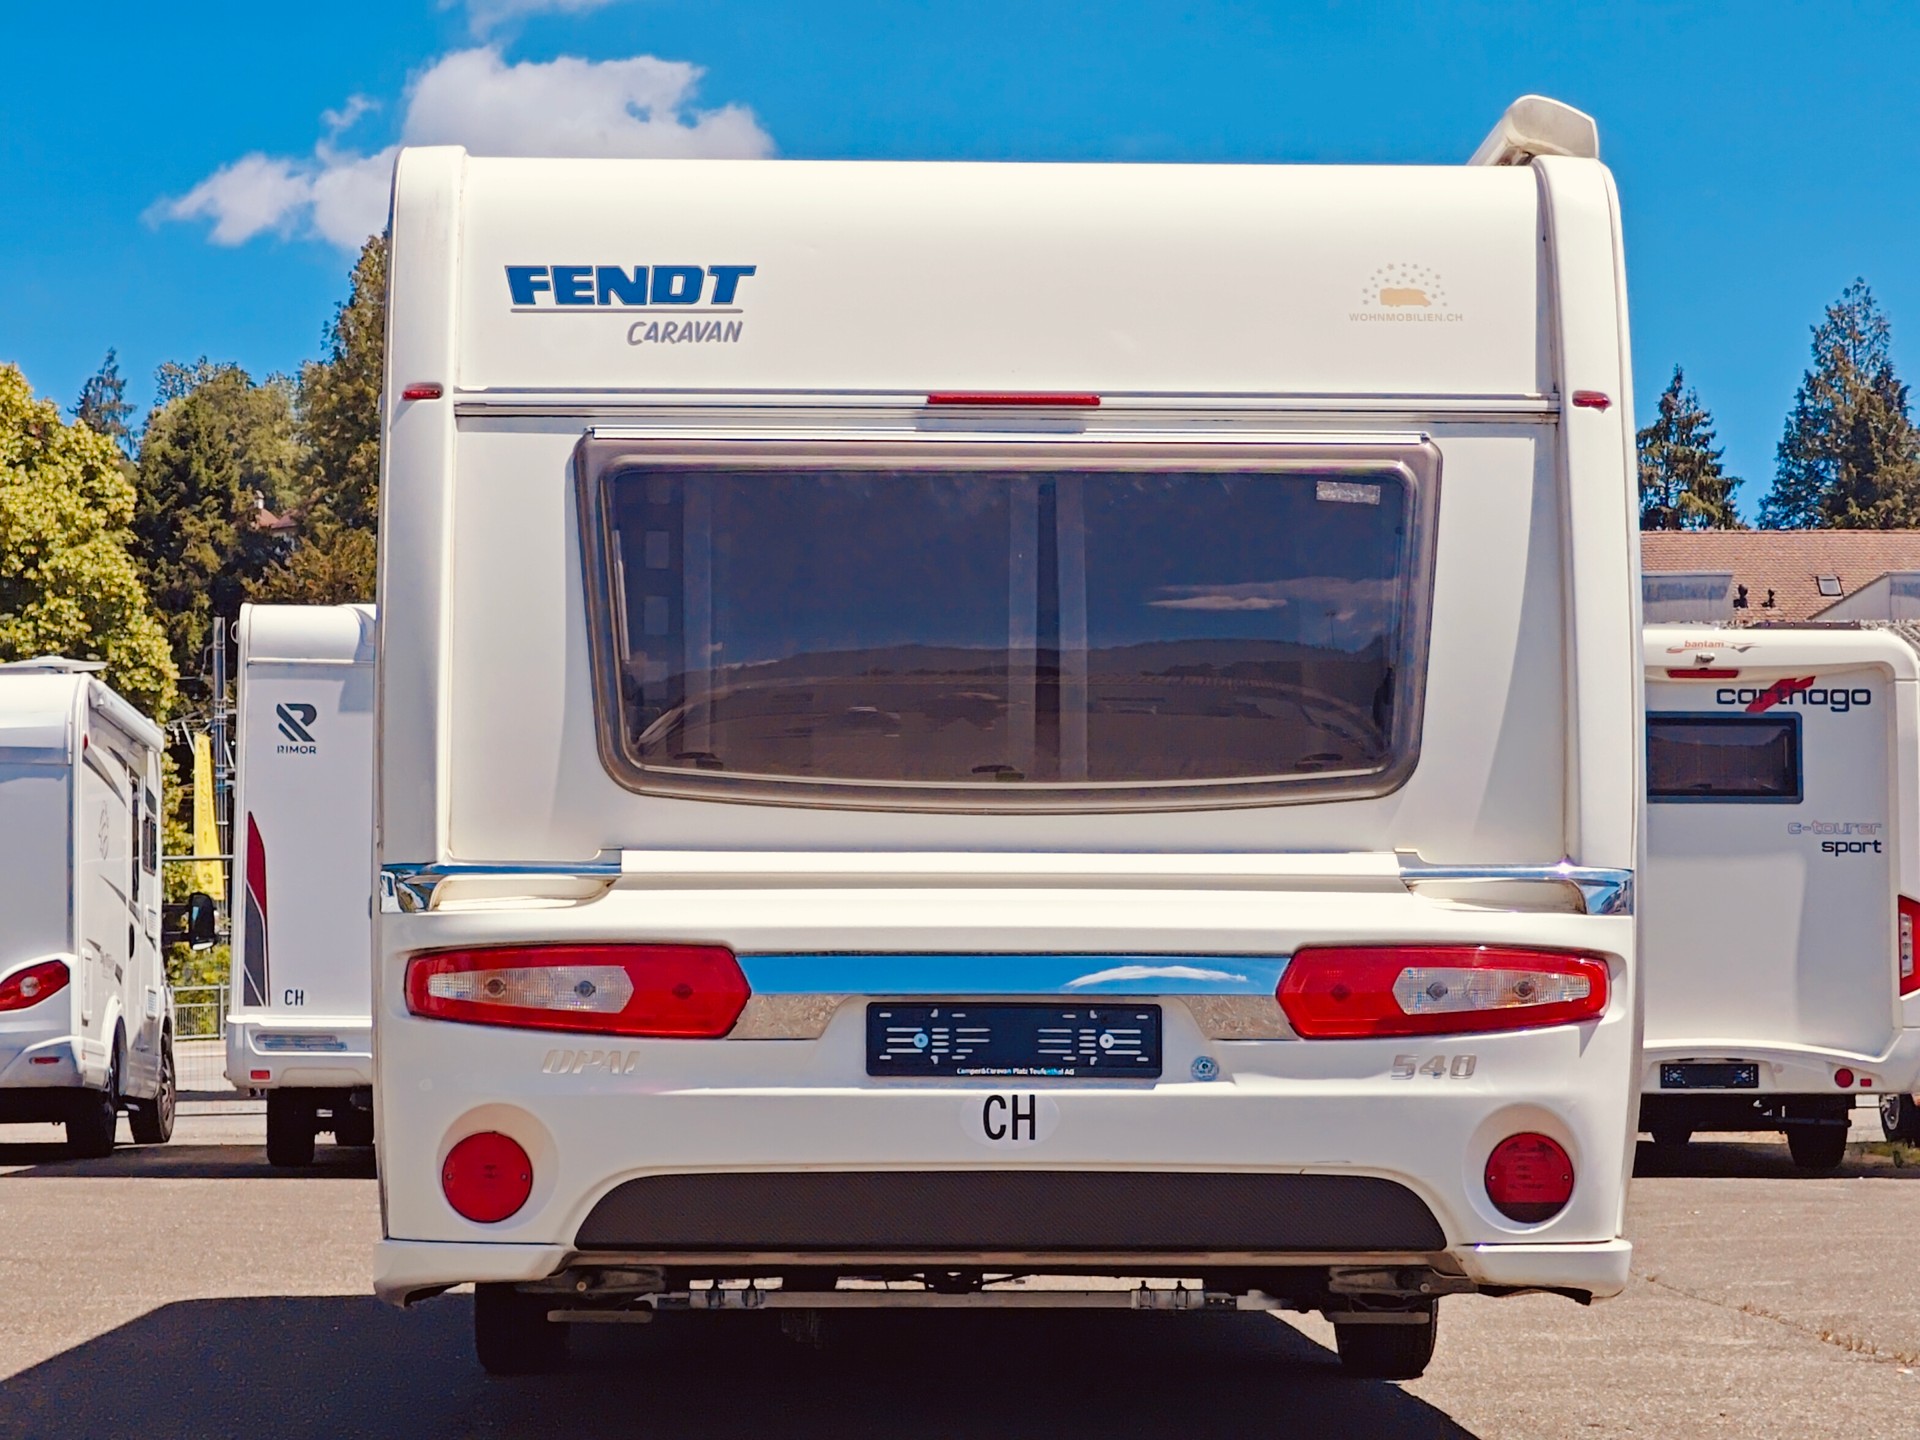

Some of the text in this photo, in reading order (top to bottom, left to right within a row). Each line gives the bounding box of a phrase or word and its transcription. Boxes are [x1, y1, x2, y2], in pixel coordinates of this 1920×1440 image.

[504, 265, 757, 305] FENDT
[1349, 313, 1463, 322] WOHNMOBILIEN.CH
[627, 320, 743, 346] CARAVAN
[1684, 640, 1725, 648] bantam
[276, 745, 317, 754] RIMOR
[1788, 820, 1882, 835] c-tourer
[1821, 840, 1882, 857] sport
[284, 989, 304, 1006] CH
[1391, 1054, 1477, 1080] 540
[982, 1094, 1036, 1141] CH
